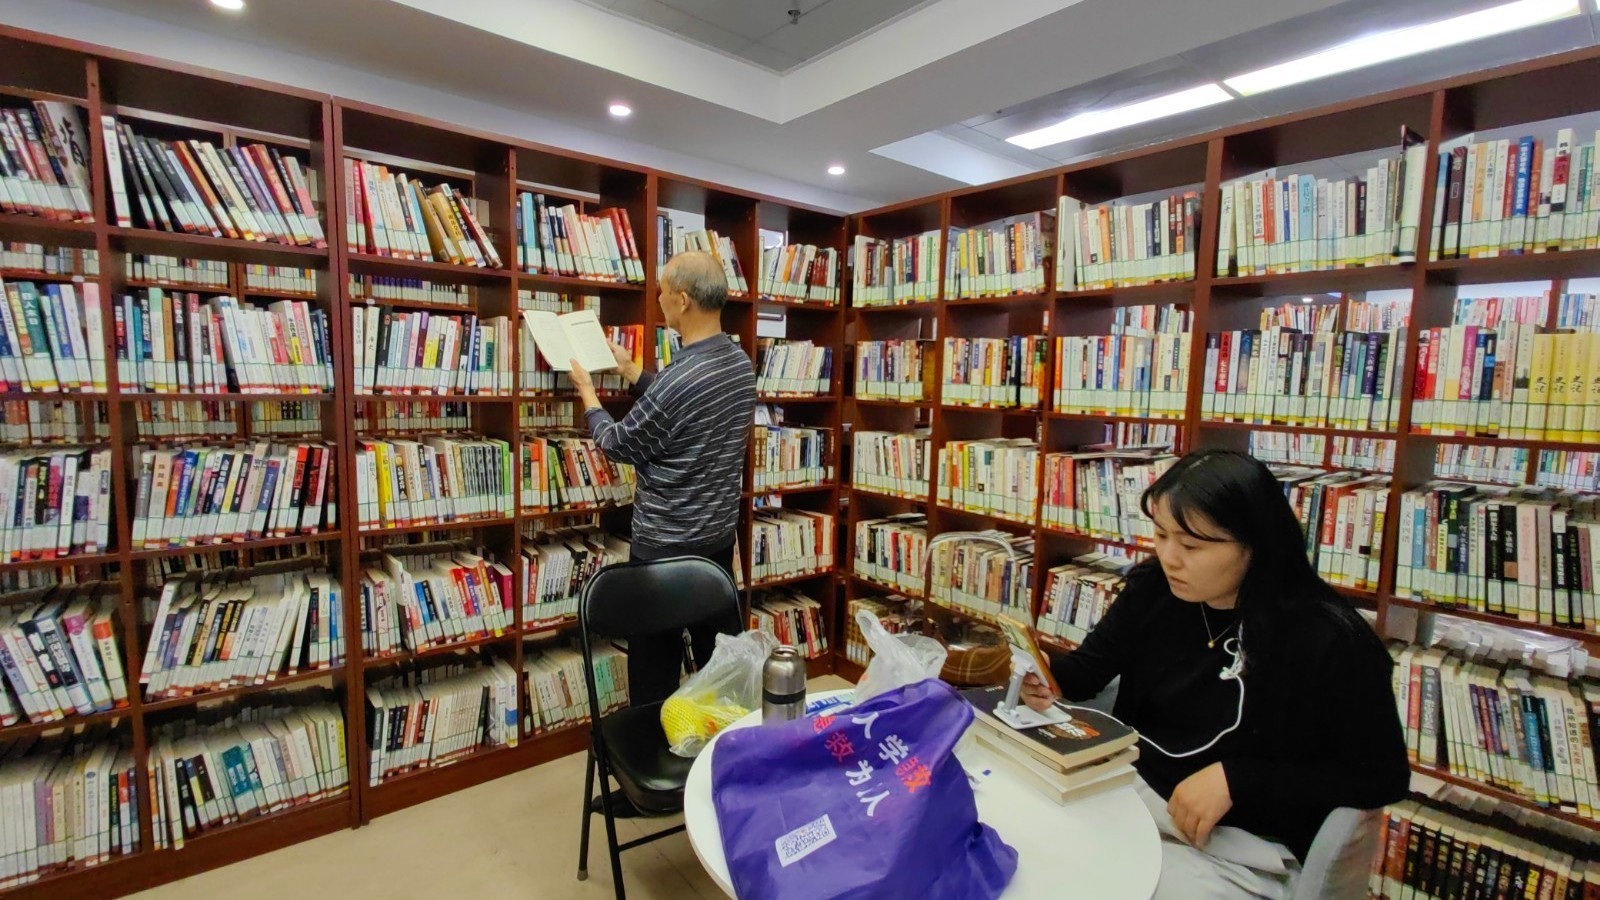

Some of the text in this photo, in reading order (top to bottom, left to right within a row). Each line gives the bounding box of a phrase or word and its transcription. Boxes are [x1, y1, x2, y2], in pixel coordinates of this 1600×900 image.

[1535, 376, 1547, 393] 史记
[1554, 376, 1566, 393] 史记
[1572, 376, 1584, 393] 史记
